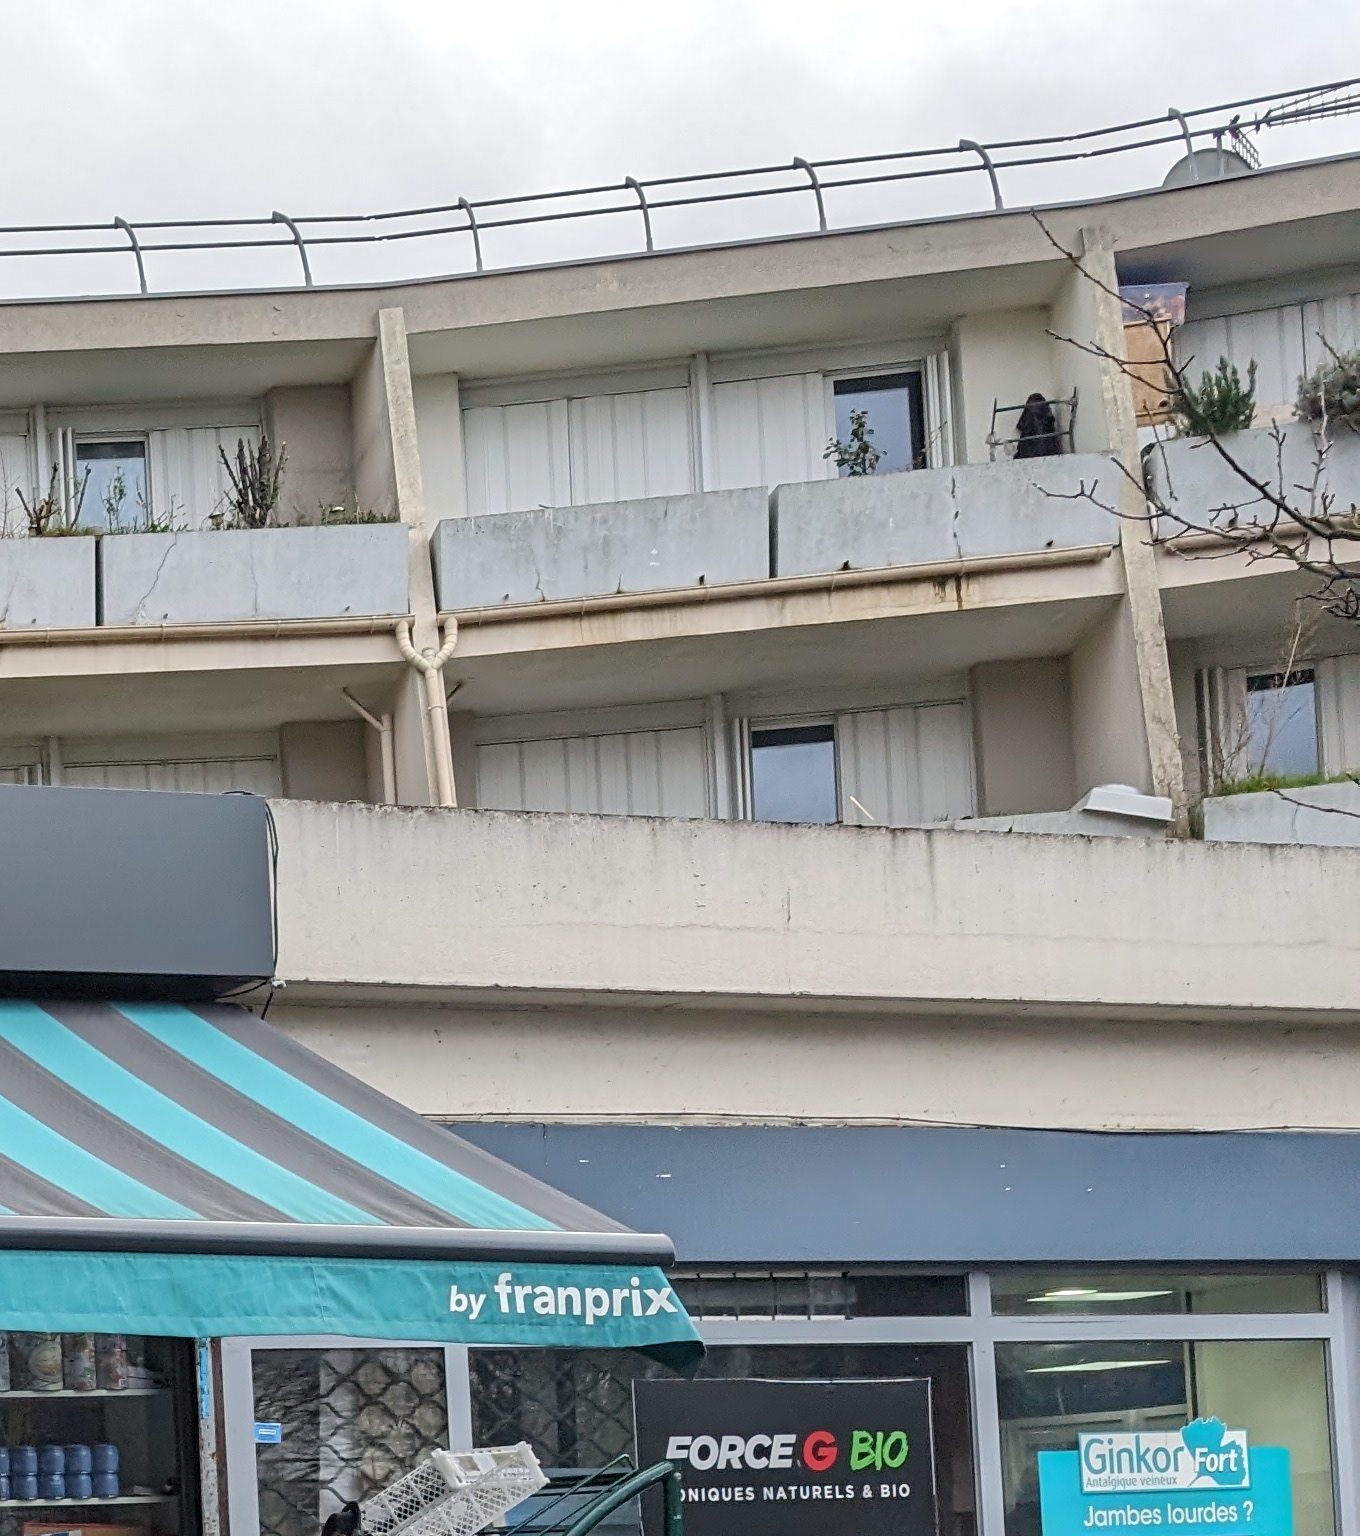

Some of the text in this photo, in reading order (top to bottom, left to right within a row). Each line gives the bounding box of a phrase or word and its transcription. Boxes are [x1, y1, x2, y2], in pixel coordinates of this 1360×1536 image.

[449, 1273, 678, 1325] by franprix
[666, 1430, 909, 1471] FORCE G BIO
[1084, 1434, 1238, 1475] Ginkor Fort
[680, 1483, 911, 1502] NIQUES NATURELS & BIO
[1086, 1474, 1178, 1490] Antalgique veineux
[1083, 1504, 1162, 1528] Jambes
[1167, 1502, 1238, 1525] lourdes
